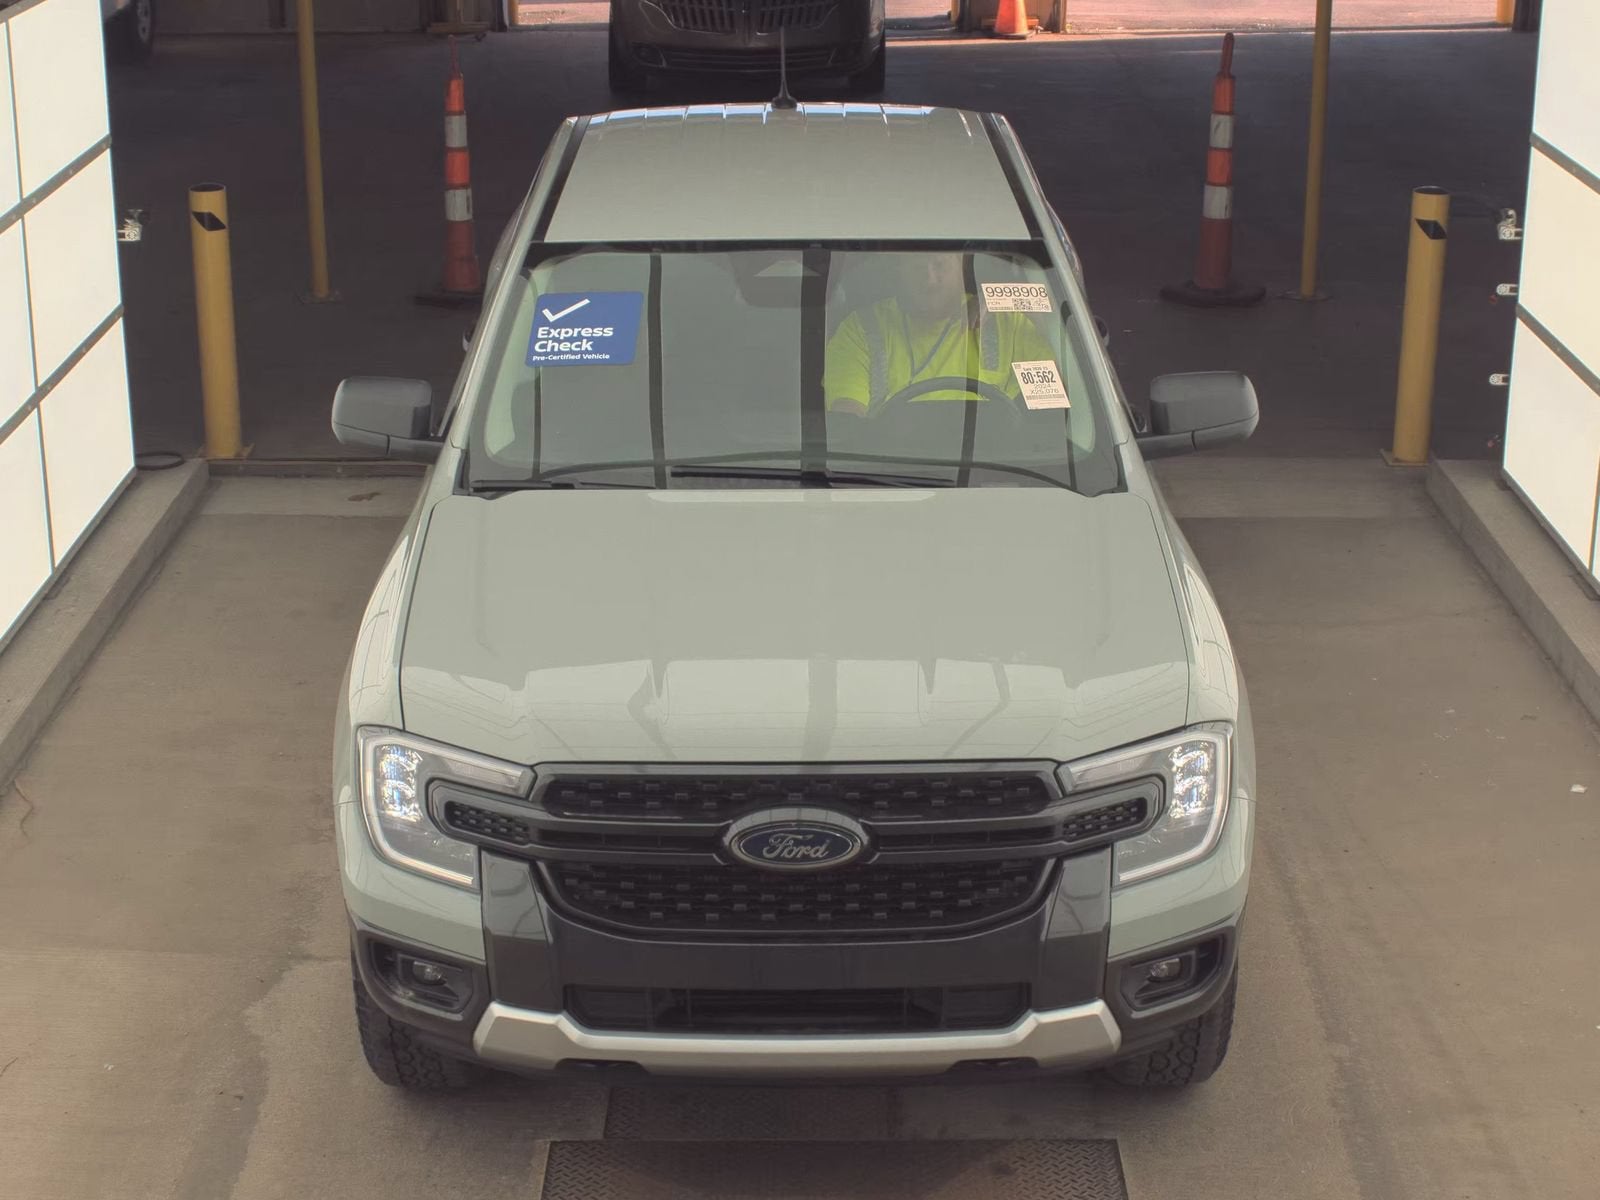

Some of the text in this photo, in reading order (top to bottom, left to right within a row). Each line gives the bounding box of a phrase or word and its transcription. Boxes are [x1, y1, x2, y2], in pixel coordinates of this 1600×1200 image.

[985, 286, 1048, 298] 9998908
[537, 327, 613, 339] Express
[534, 339, 593, 352] Check
[532, 353, 581, 361] Pre-Certified
[1020, 370, 1056, 384] 80:562
[762, 833, 830, 859] Ford
